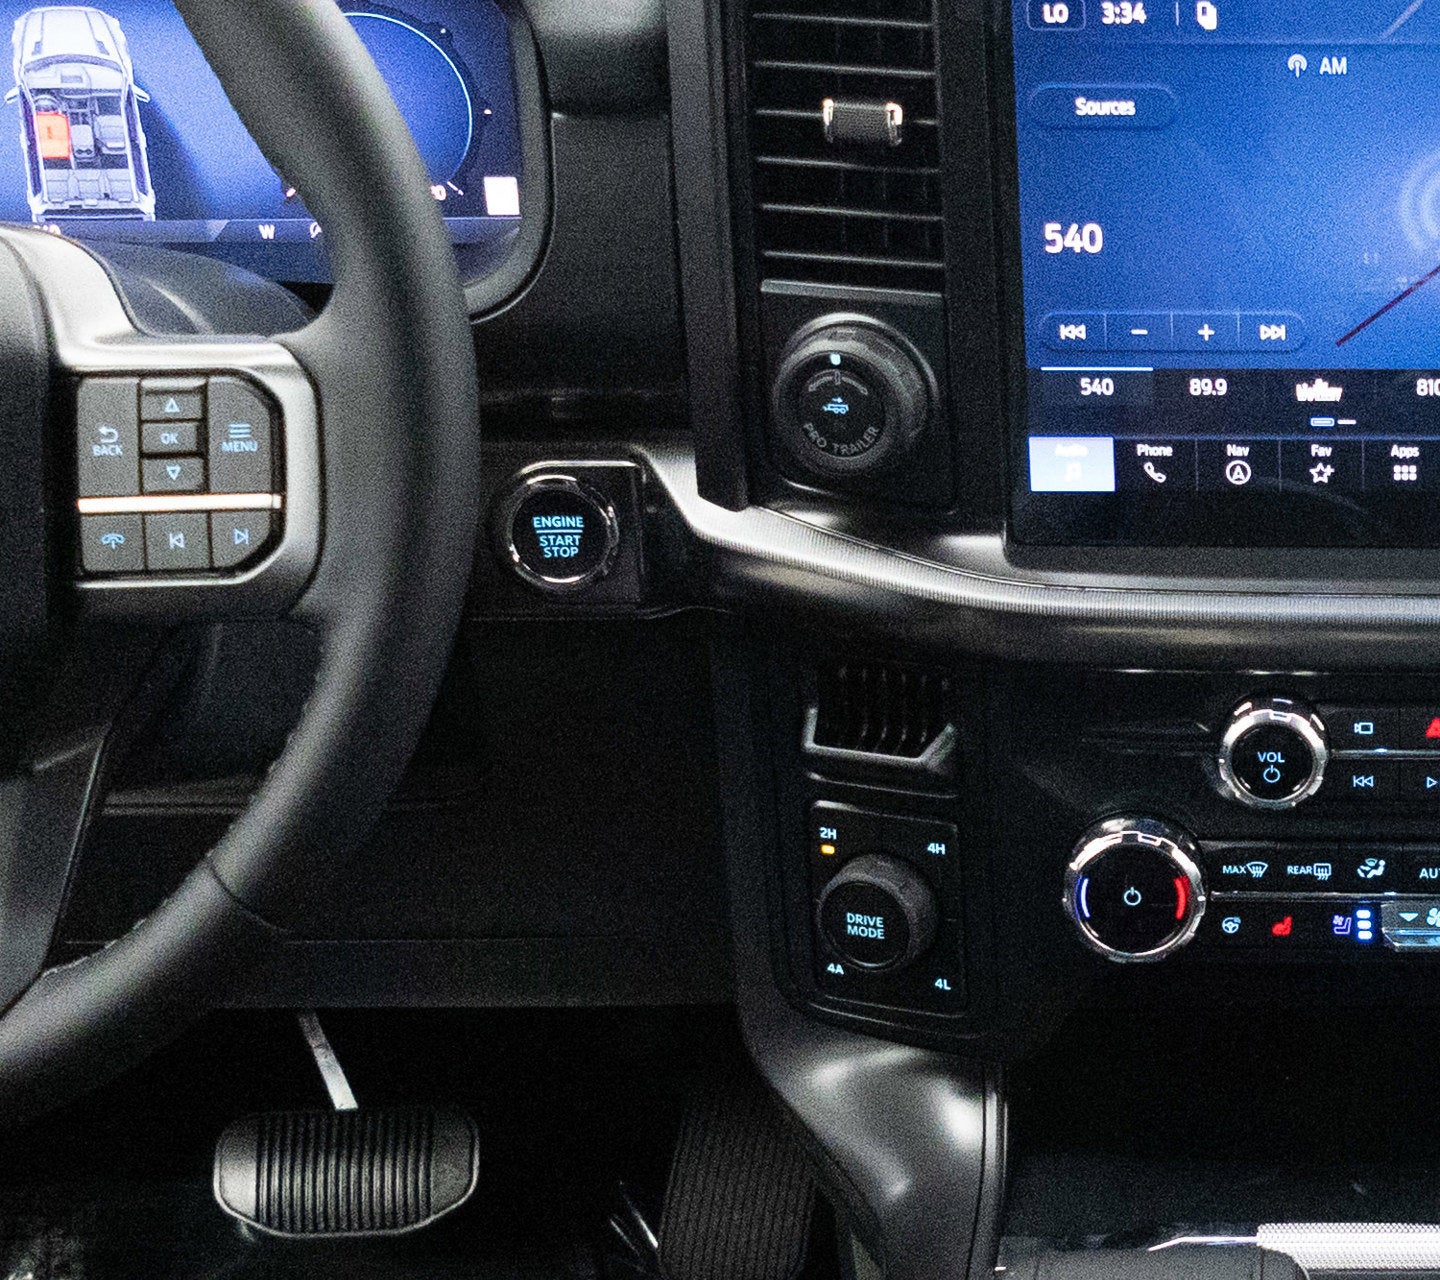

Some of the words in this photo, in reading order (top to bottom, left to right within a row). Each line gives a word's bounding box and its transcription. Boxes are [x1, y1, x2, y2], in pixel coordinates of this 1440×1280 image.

[1042, 3, 1070, 24] LO
[1101, 1, 1148, 25] 3:34
[1319, 56, 1348, 75] AM
[1075, 96, 1136, 117] Sources
[259, 225, 275, 240] W
[1043, 223, 1105, 255] 540
[1080, 377, 1115, 397] 540
[1189, 378, 1228, 398] 89.9
[161, 433, 179, 445] OK
[832, 426, 880, 455] TRAILER
[92, 444, 123, 457] BACK
[221, 440, 258, 453] MENU
[1136, 444, 1173, 459] Phone
[1226, 444, 1250, 458] Nav
[1311, 444, 1333, 458] Fav
[1390, 444, 1420, 460] Apps
[532, 515, 585, 529] ENGINE
[539, 534, 582, 547] START
[544, 546, 579, 559] STOP
[1257, 751, 1285, 763] VOL
[819, 826, 837, 840] 2H
[927, 842, 946, 855] 4H
[1222, 865, 1247, 875] MAX
[1287, 865, 1312, 875] REAR
[846, 912, 884, 928] DRIVE
[846, 925, 885, 940] MODE
[826, 962, 845, 976] 4A
[934, 977, 951, 991] 4L
